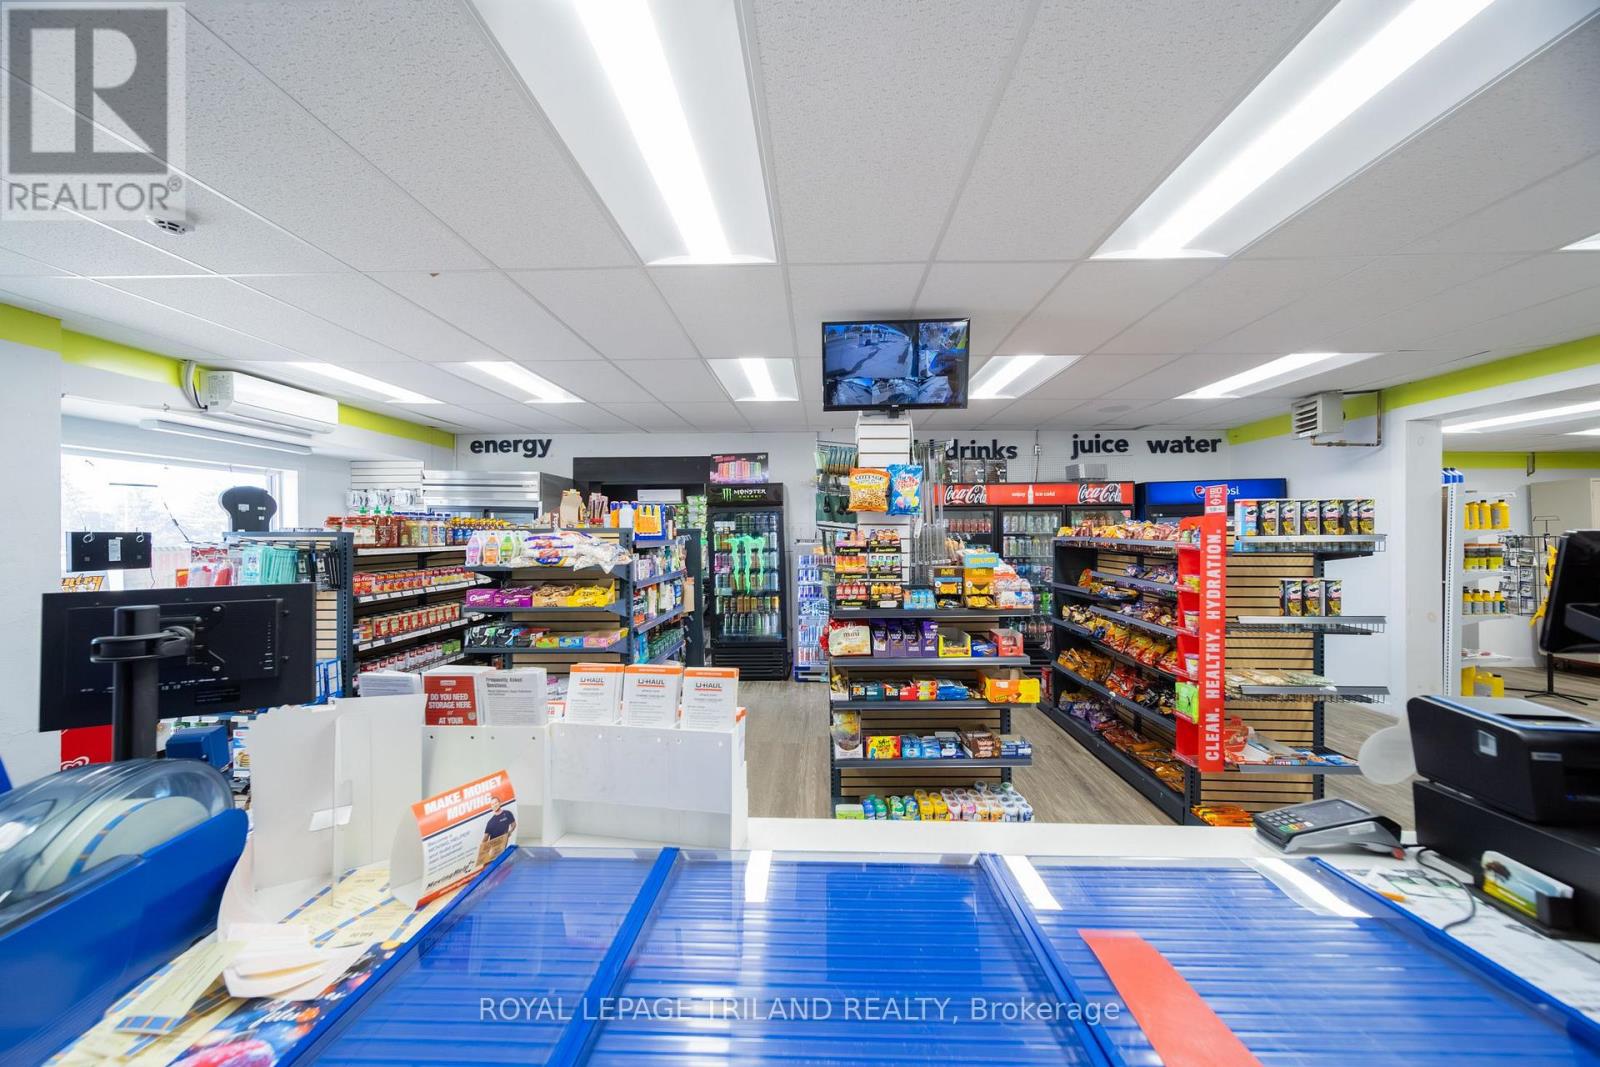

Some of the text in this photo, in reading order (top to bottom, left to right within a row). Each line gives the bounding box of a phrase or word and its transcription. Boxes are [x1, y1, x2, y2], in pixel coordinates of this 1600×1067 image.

[470, 439, 552, 458] energy
[945, 439, 1018, 460] drinks
[1071, 434, 1222, 460] juice water
[1206, 529, 1222, 620] HYDRATION.
[1205, 629, 1221, 699] HEALTHY.
[1205, 708, 1220, 761] CLEAN.
[423, 776, 503, 816] MAKE MONEY
[447, 793, 491, 820] MOVING
